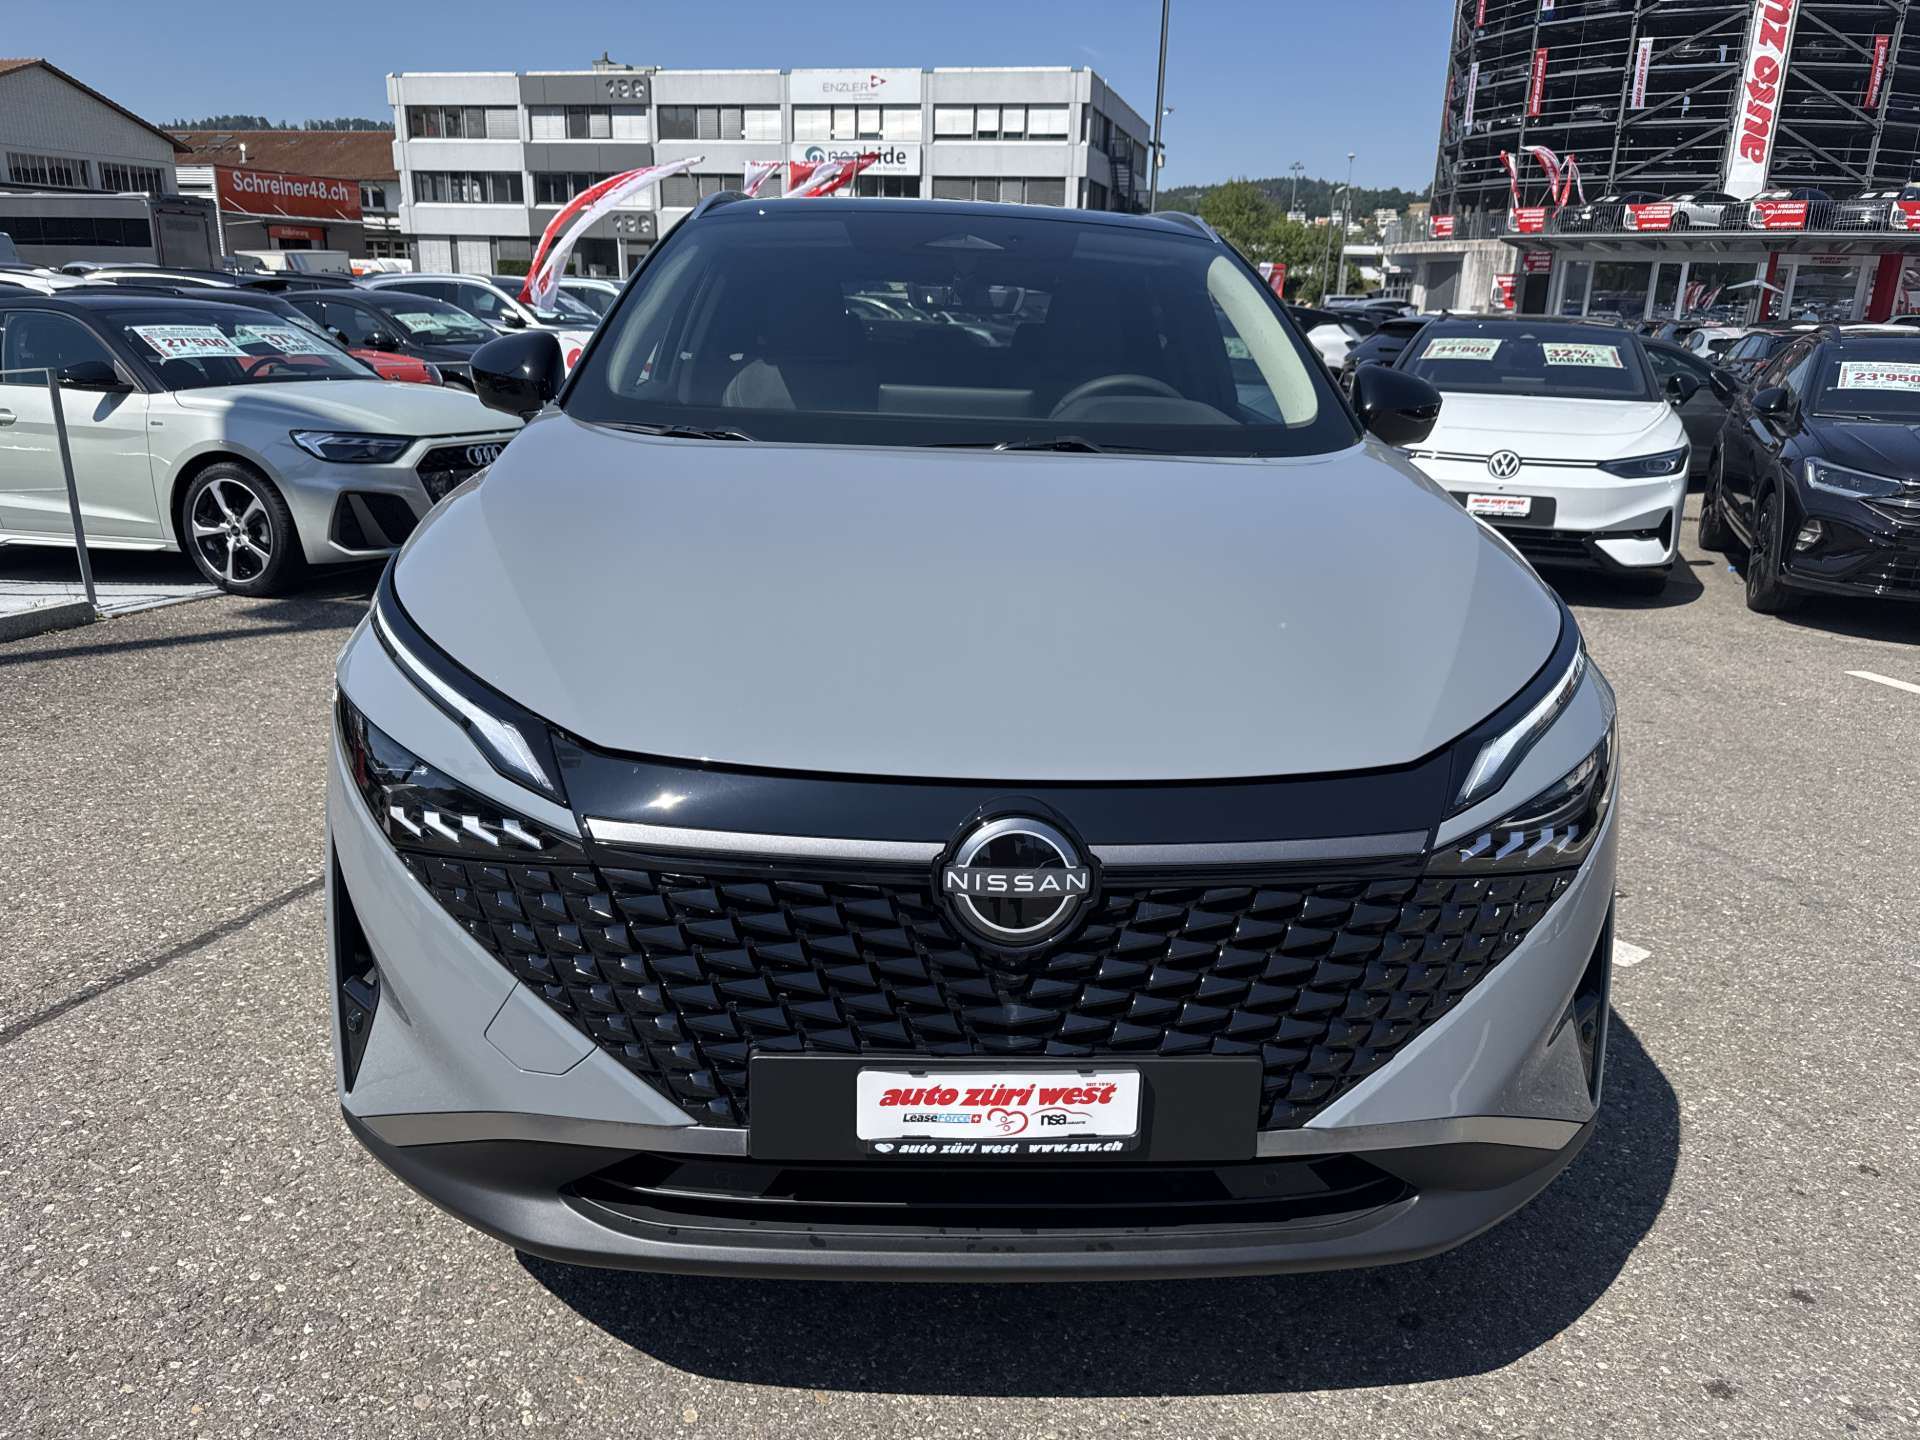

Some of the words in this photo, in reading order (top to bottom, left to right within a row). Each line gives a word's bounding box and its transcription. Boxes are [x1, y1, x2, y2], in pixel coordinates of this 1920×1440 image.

[822, 82, 869, 92] ENZLER
[1740, 55, 1780, 164] auto
[232, 171, 349, 201] Schreiner48.ch
[161, 337, 230, 348] 27'500
[1546, 348, 1595, 358] 32%
[1549, 356, 1597, 364] RABATT
[1854, 372, 1920, 383] 23'950
[947, 869, 1087, 892] NISSAN
[879, 1084, 960, 1107] auto
[960, 1083, 1037, 1107] züri
[1038, 1083, 1118, 1105] west
[903, 1113, 971, 1123] LeaseForce
[1041, 1114, 1066, 1126] nsa
[899, 1143, 938, 1154] auto
[941, 1142, 977, 1154] züri
[981, 1143, 1019, 1154] west
[1029, 1141, 1124, 1154] www.azw.ch
